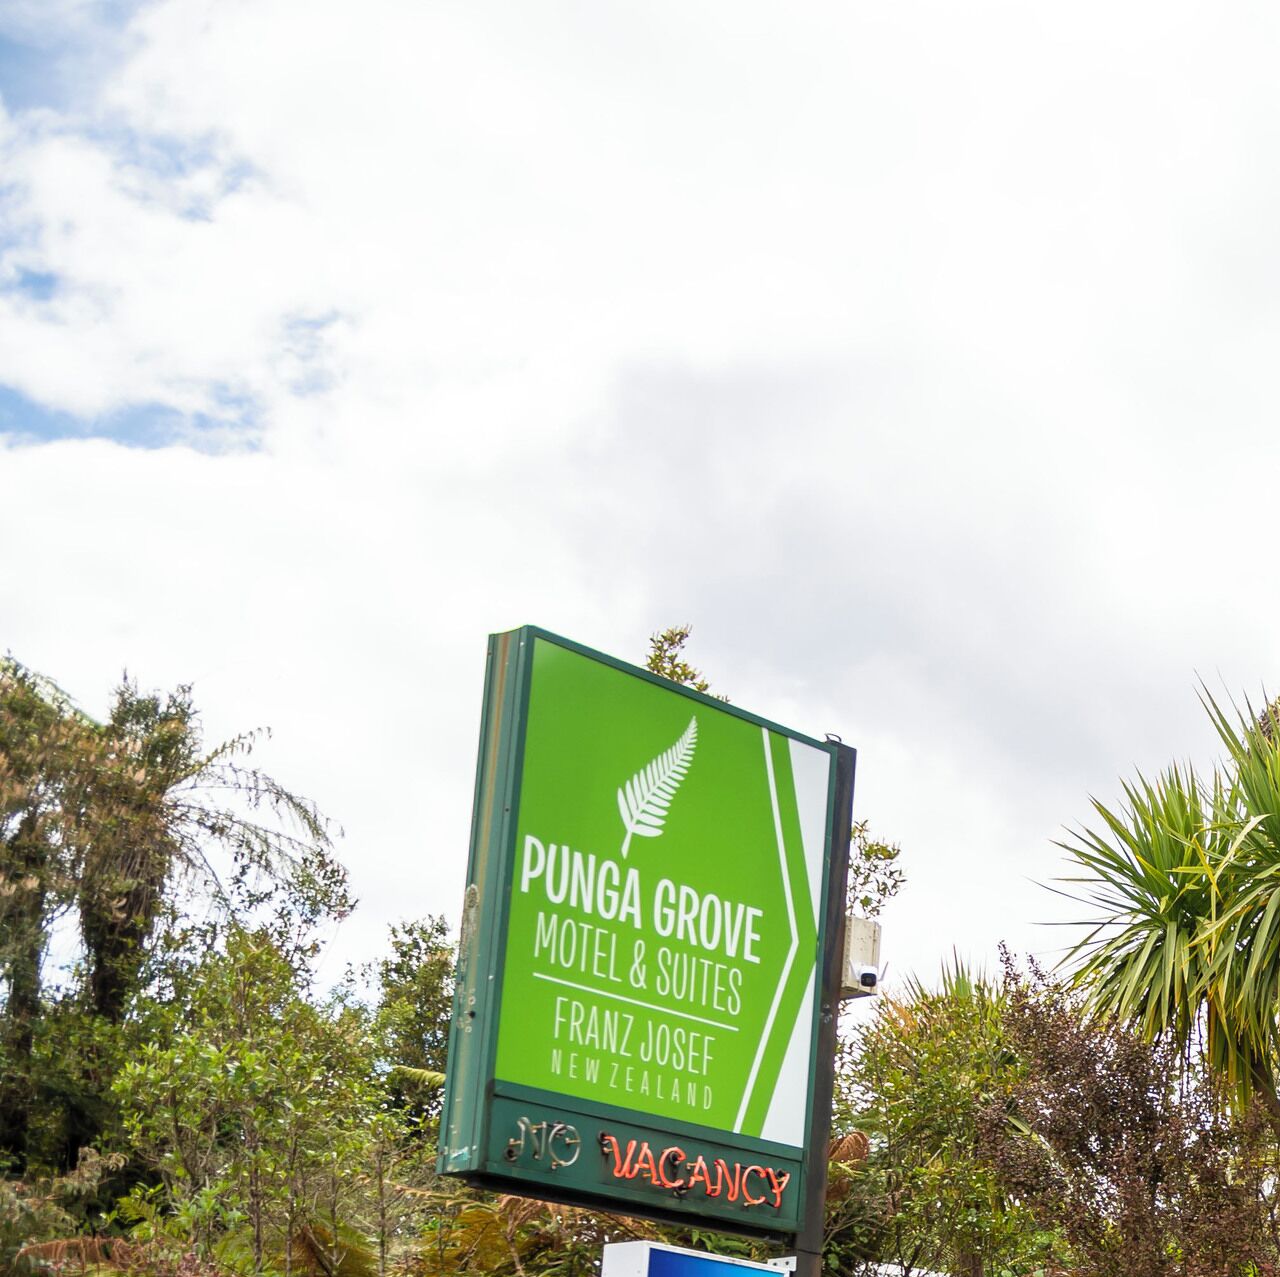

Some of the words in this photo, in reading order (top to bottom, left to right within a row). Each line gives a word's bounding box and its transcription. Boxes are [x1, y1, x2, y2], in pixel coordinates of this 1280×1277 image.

[520, 834, 642, 929] PUNGA
[653, 878, 764, 964] GROVE
[534, 911, 622, 983] MOTEL
[629, 939, 647, 989] &
[656, 947, 742, 1016] SUITES
[551, 1049, 600, 1084] NEW
[609, 1063, 712, 1110] ZEALAND
[554, 996, 635, 1057] FRANZ
[640, 1020, 716, 1076] JOSEF
[507, 1116, 580, 1167] NO
[603, 1135, 790, 1208] VACANCY
